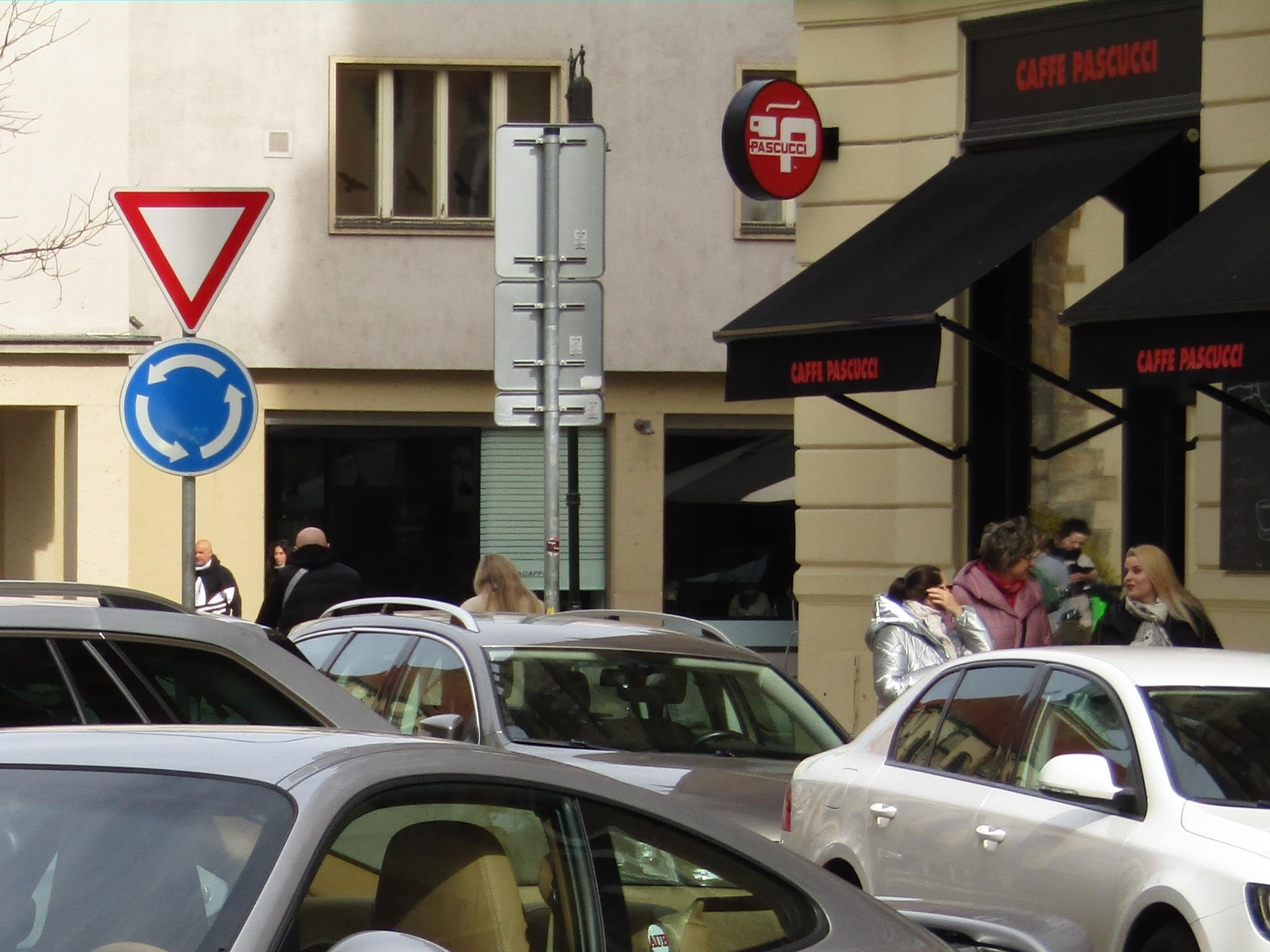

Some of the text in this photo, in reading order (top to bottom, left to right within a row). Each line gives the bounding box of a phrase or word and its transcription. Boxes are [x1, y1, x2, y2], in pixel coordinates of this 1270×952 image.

[1016, 39, 1158, 91] CAFFE PASCUCCI
[750, 141, 807, 155] PASCUCCI
[791, 357, 878, 384] CAFFE PASCUCCI
[1136, 343, 1244, 373] CAFFE PASCUCCI
